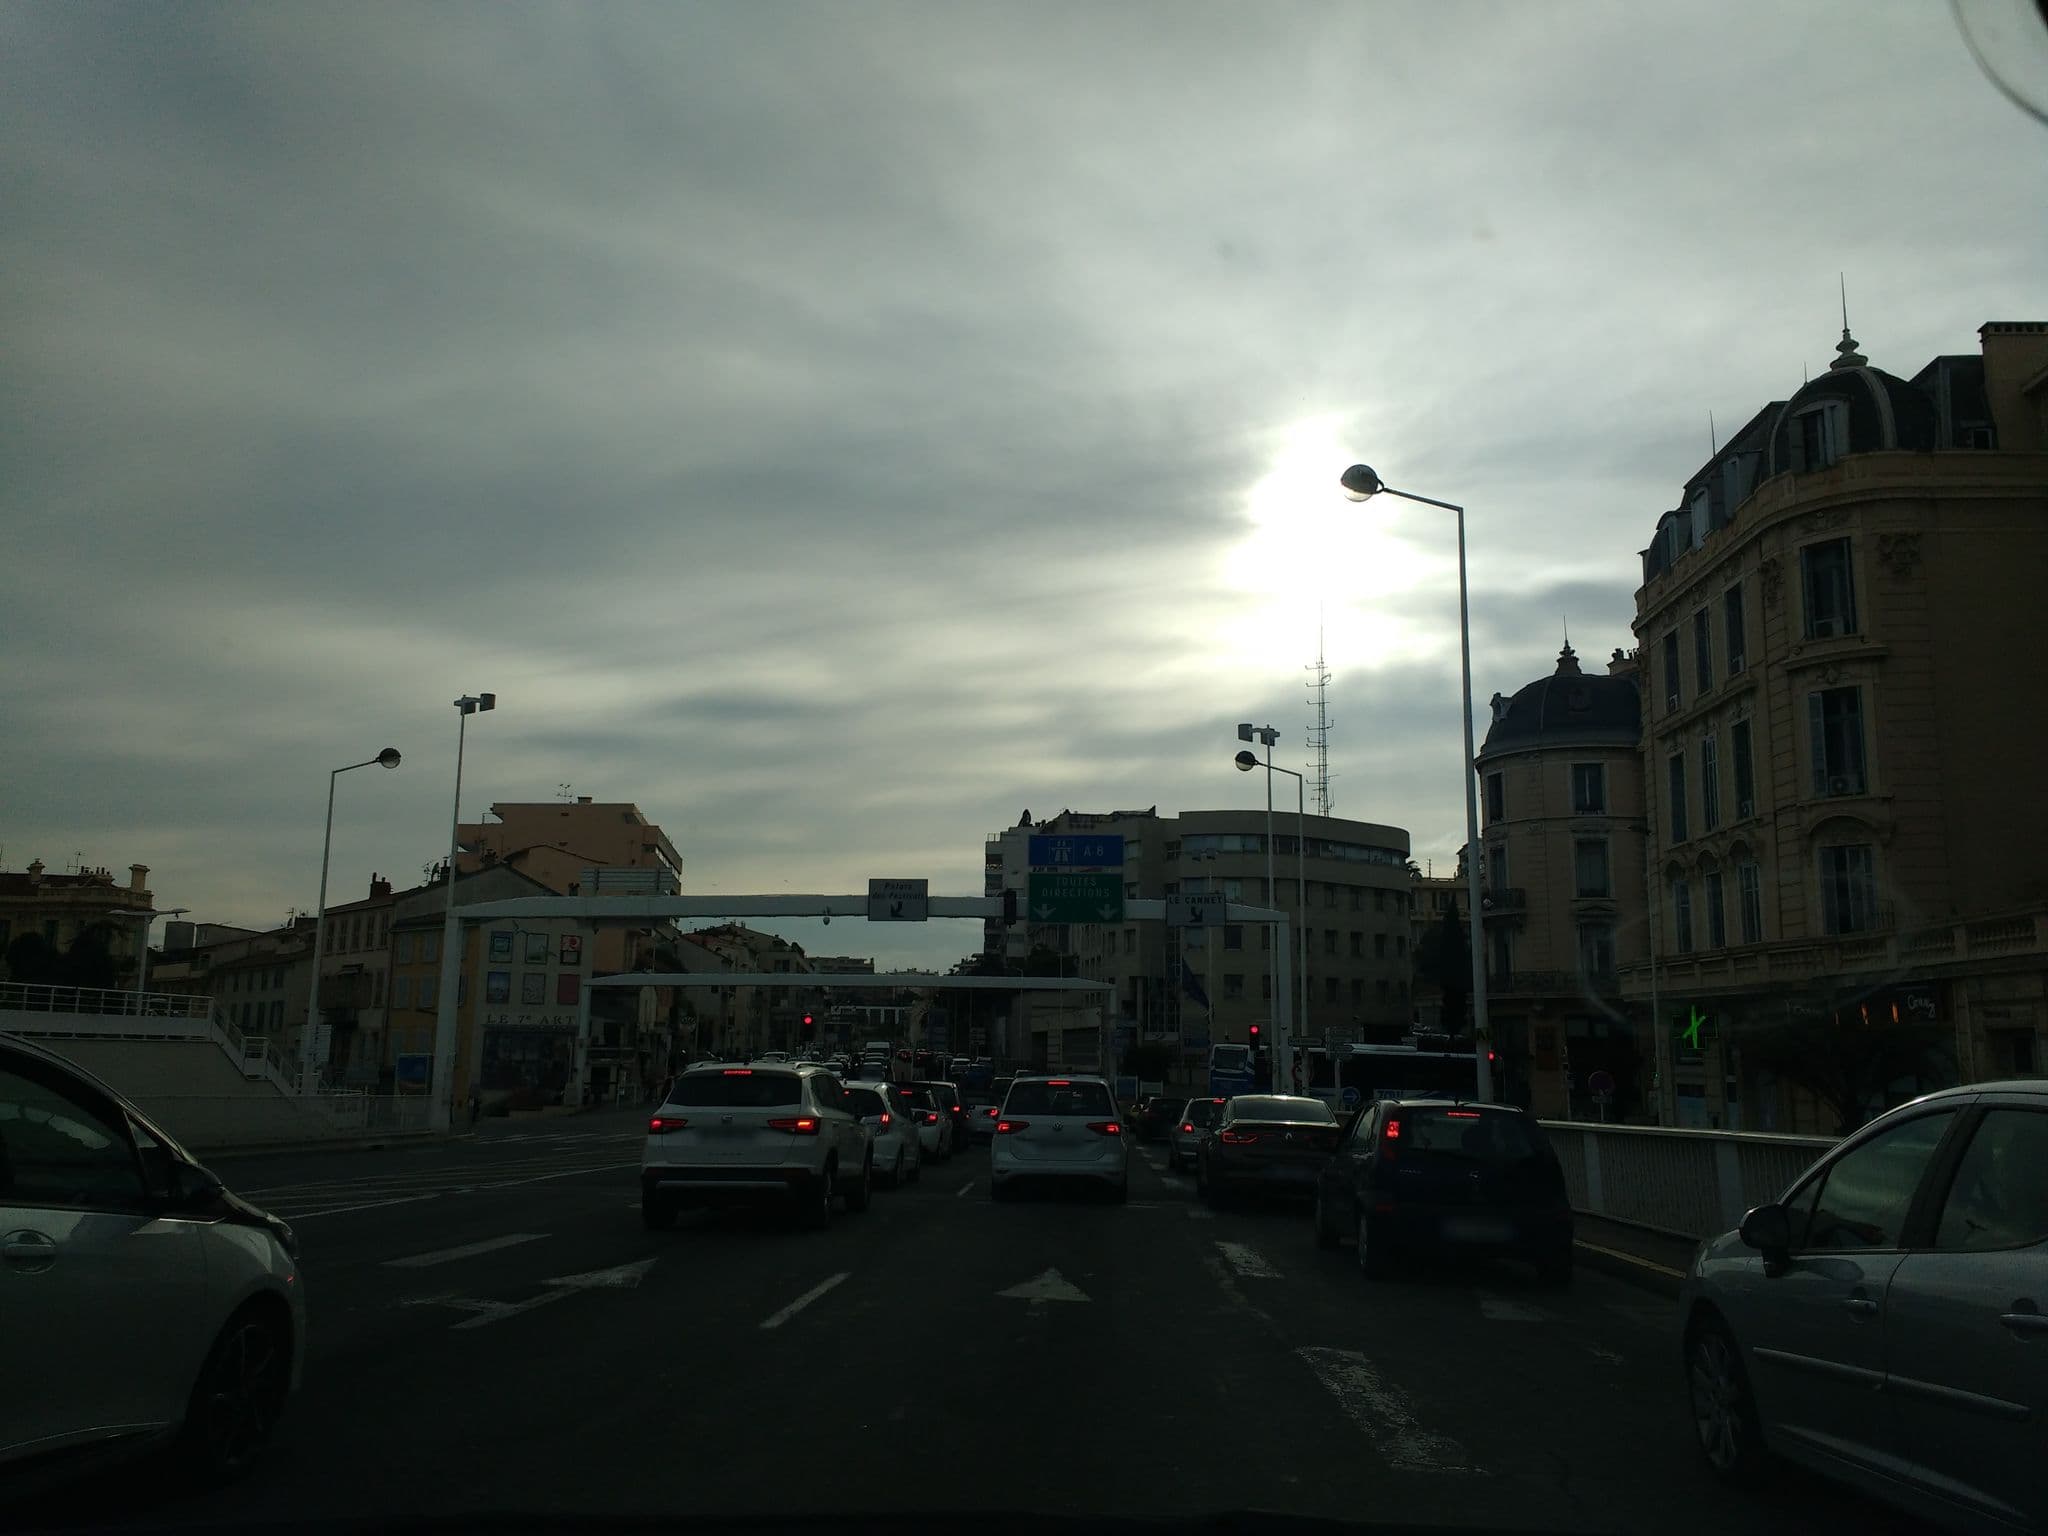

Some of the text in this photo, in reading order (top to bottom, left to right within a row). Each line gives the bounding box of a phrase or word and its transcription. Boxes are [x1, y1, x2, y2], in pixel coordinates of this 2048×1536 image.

[1056, 876, 1097, 887] TOUTES
[1041, 887, 1111, 897] DIRECTIONS
[1168, 895, 1223, 904] LE CANNET
[487, 1014, 509, 1024] LE
[539, 1014, 577, 1024] ART
